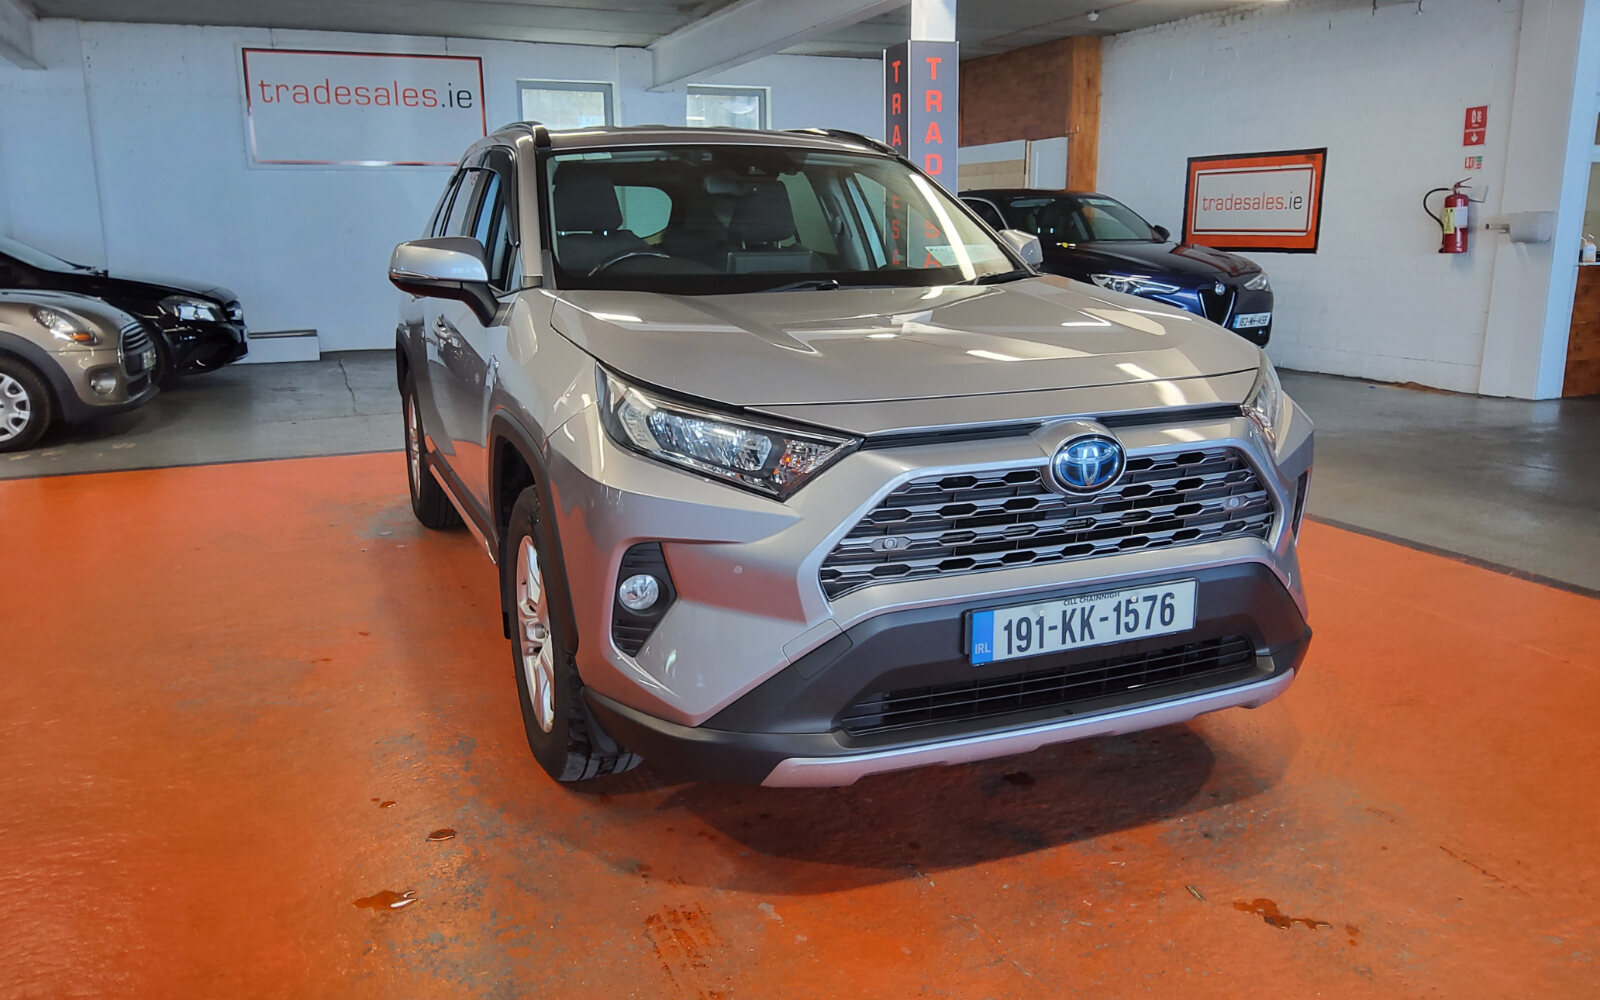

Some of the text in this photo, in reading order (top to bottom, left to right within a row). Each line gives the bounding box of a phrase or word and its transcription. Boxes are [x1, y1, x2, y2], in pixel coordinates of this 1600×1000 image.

[259, 78, 472, 109] tradesales.ie
[1202, 191, 1303, 212] tradesales.ie
[1003, 592, 1175, 655] 191-KK-1576
[974, 642, 991, 655] IRL
